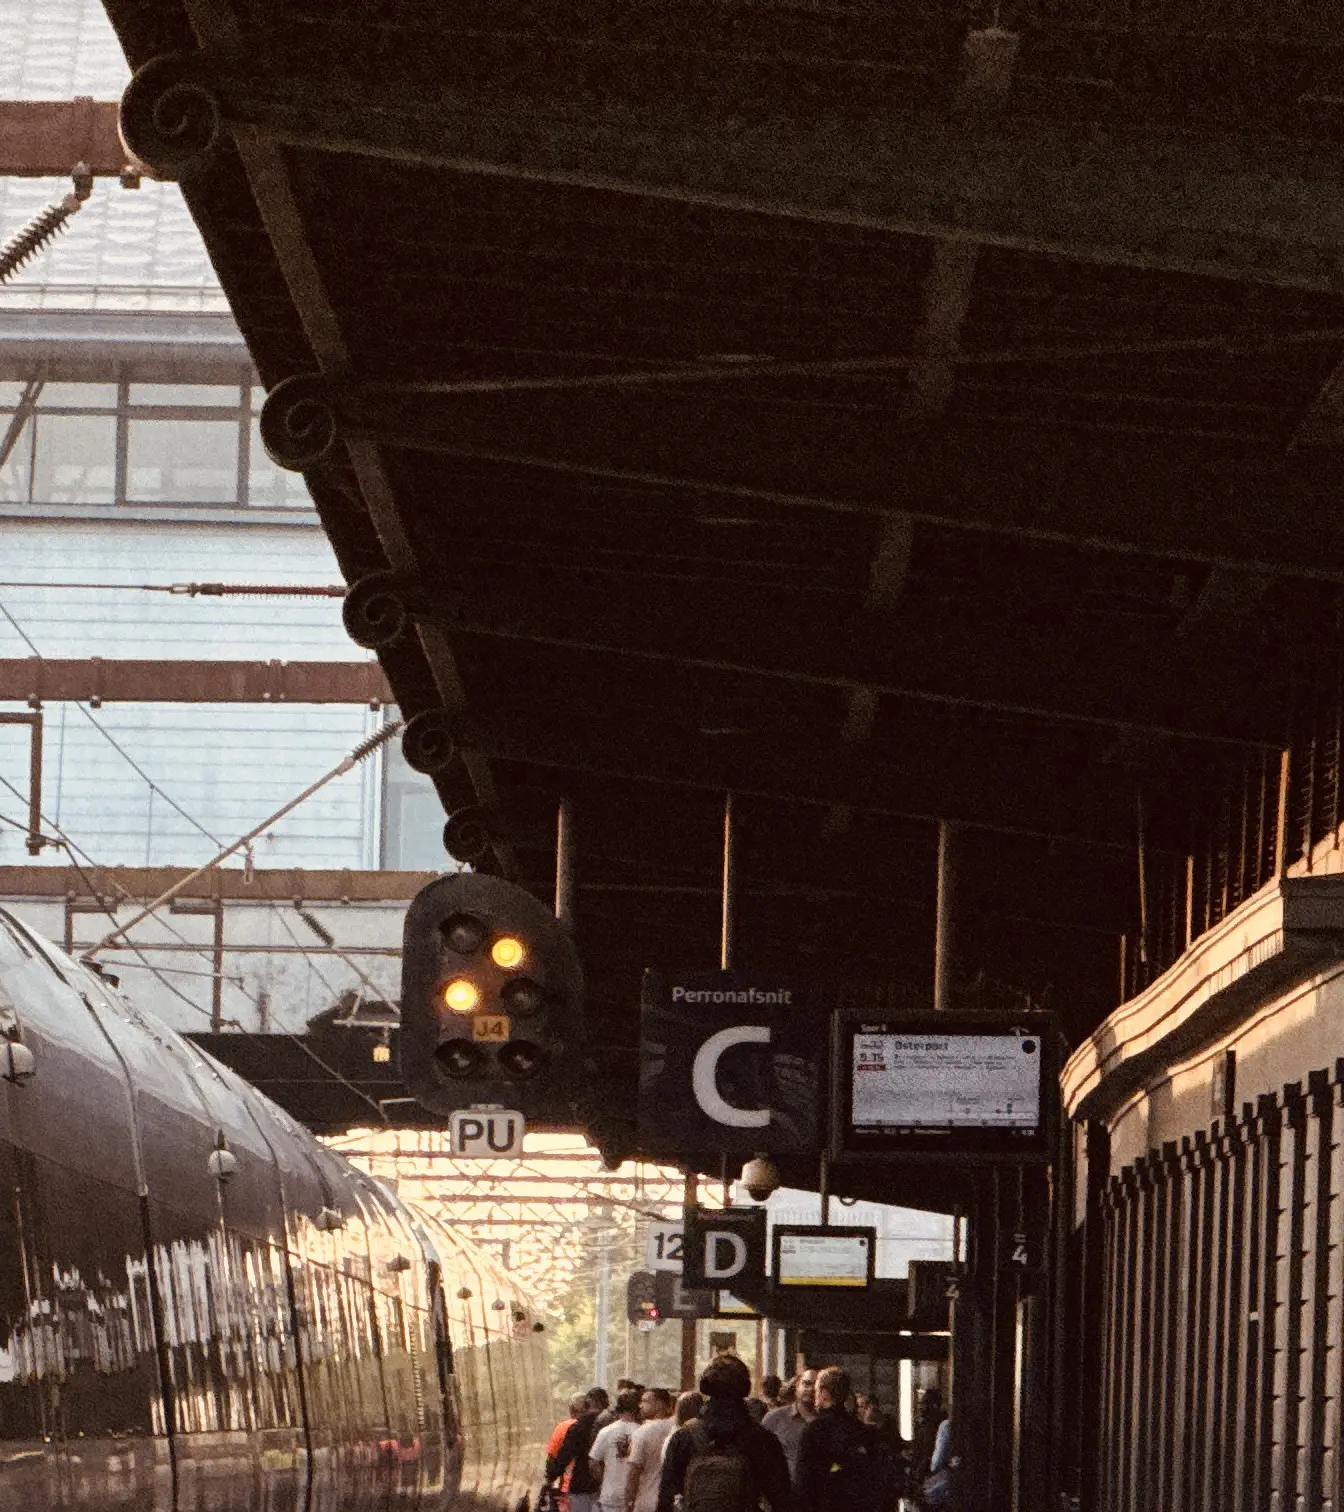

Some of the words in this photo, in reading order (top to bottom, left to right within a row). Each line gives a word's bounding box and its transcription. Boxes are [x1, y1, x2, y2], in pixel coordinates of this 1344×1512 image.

[672, 985, 792, 1005] Perronafsnit
[476, 1019, 504, 1037] J4
[692, 1024, 771, 1129] C
[458, 1118, 516, 1153] PU
[653, 1231, 684, 1261] 12
[704, 1230, 748, 1279] D
[1012, 1244, 1028, 1265] 4
